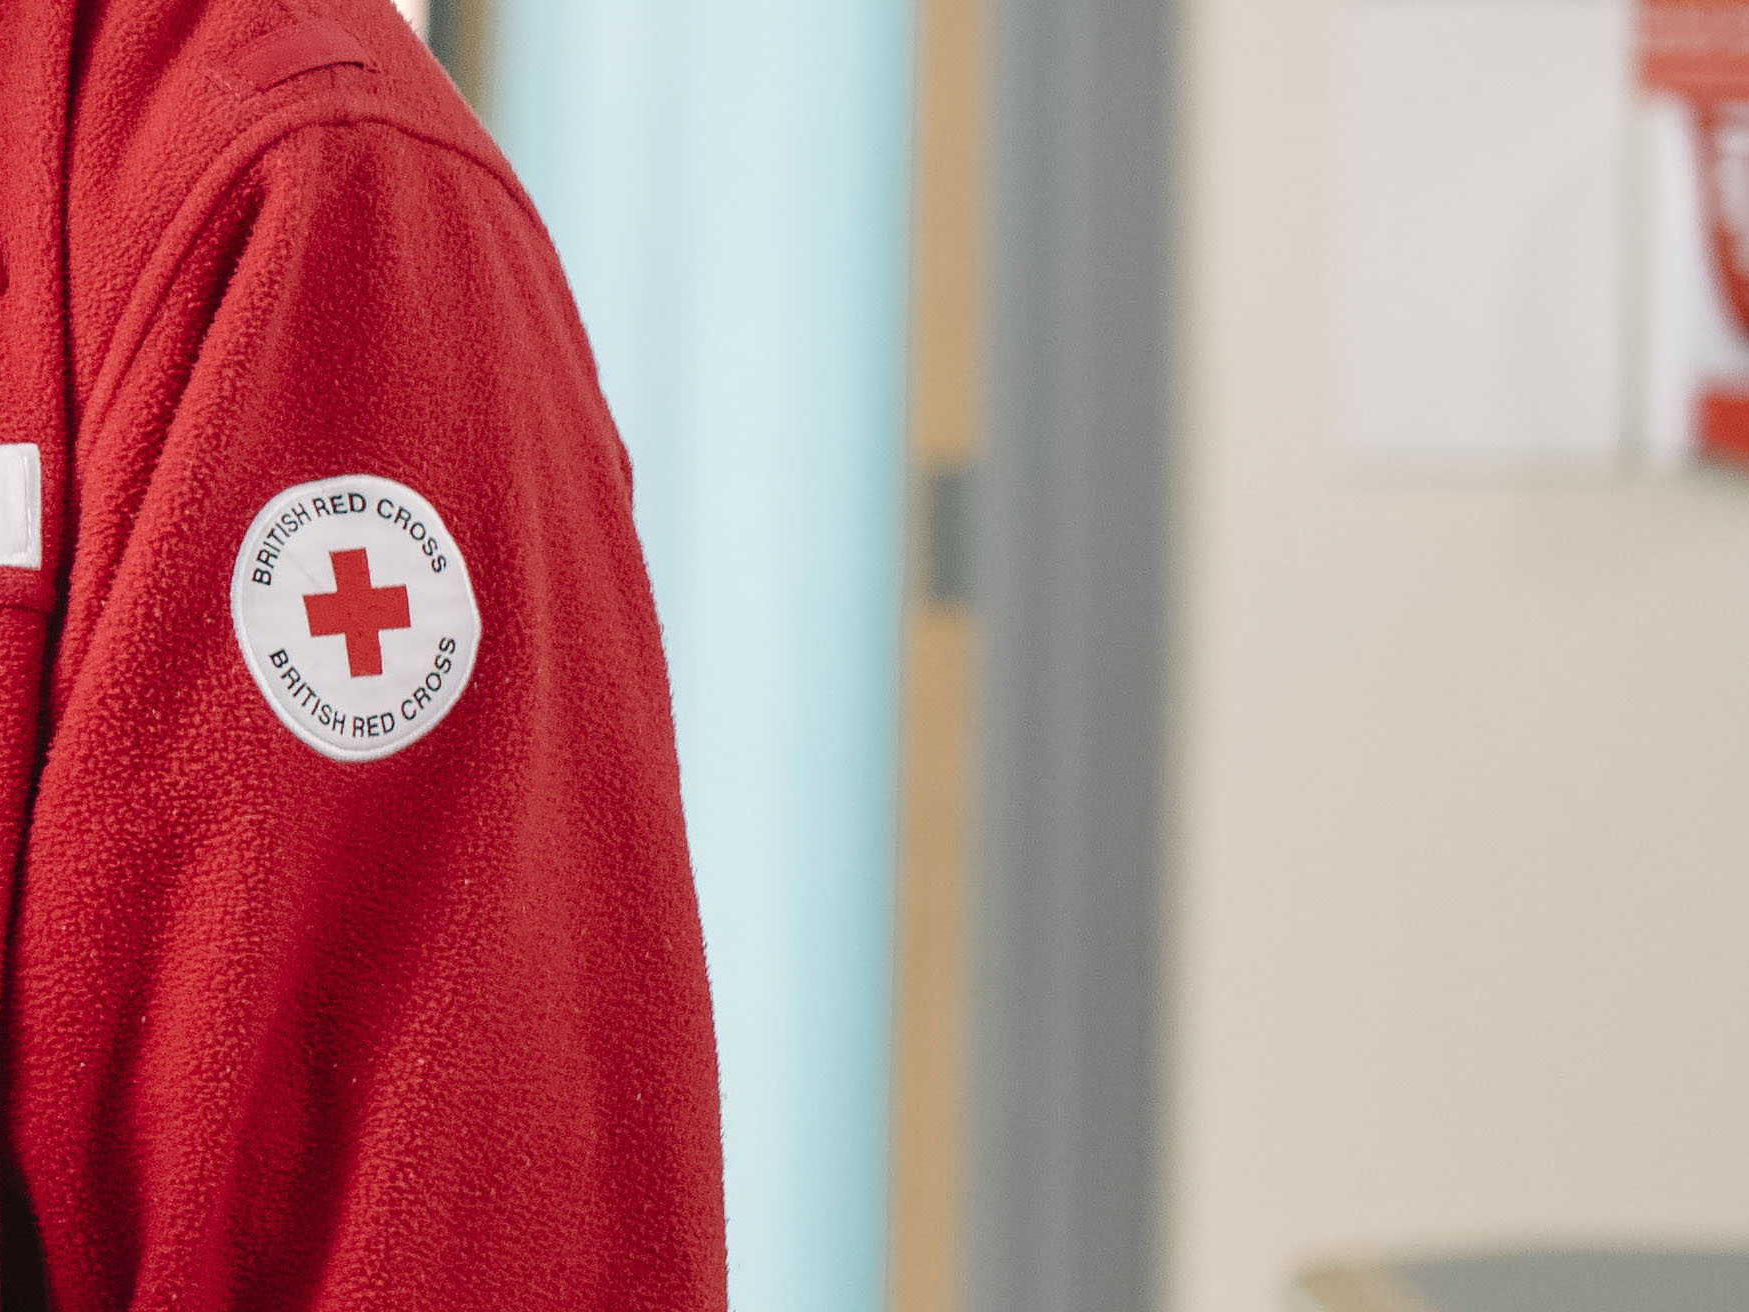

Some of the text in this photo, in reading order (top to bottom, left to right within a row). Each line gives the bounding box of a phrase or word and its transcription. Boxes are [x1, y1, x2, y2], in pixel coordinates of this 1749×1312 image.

[250, 492, 446, 588] BRITISH RED CROSS
[269, 635, 457, 739] BRITISH RED CROSS
